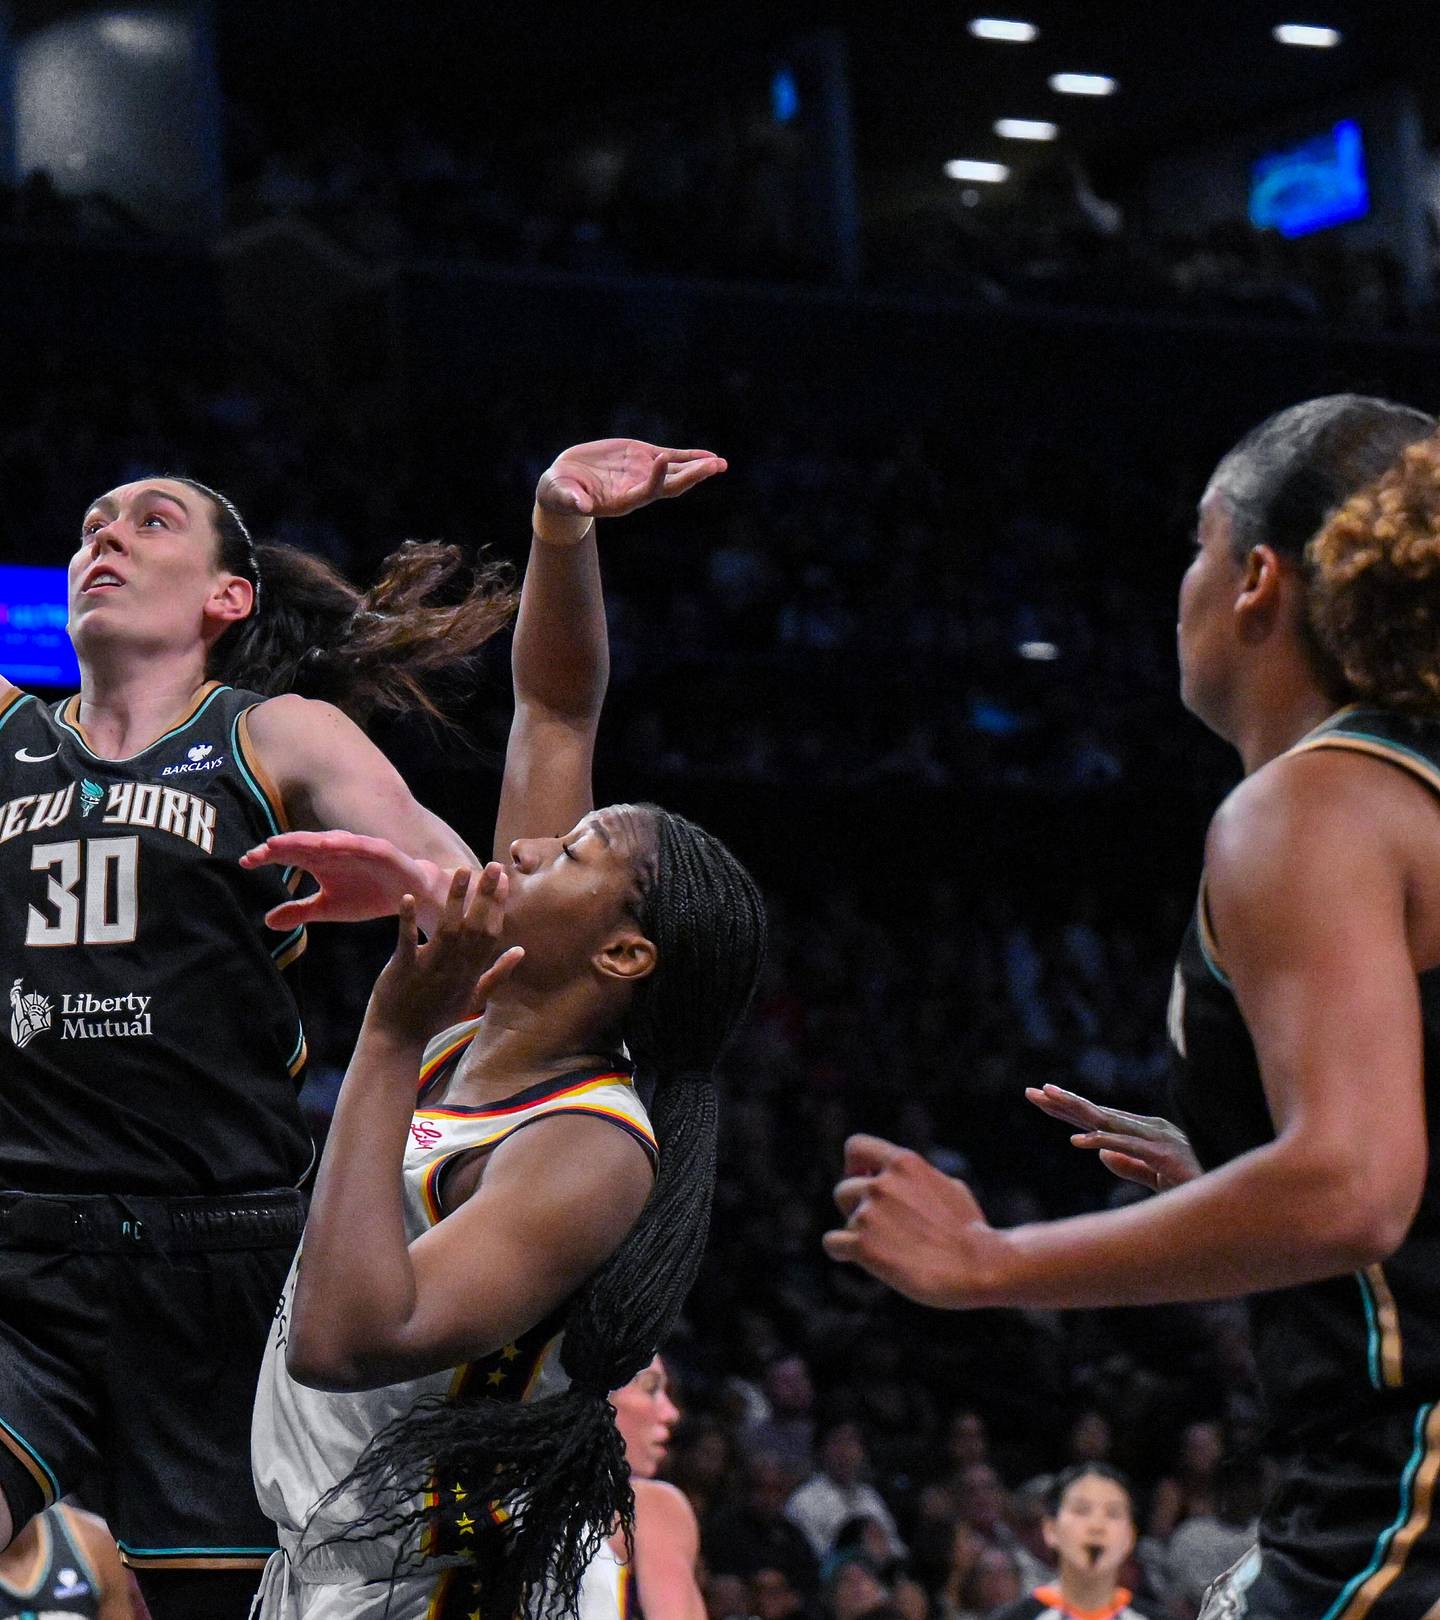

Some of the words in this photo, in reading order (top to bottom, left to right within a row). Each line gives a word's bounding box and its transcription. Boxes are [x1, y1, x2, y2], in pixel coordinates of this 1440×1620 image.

[162, 756, 224, 776] BARCLAYS
[102, 781, 218, 855] YORK
[24, 834, 140, 948] 30
[61, 992, 152, 1020] Liberty
[61, 1013, 153, 1040] Mutual
